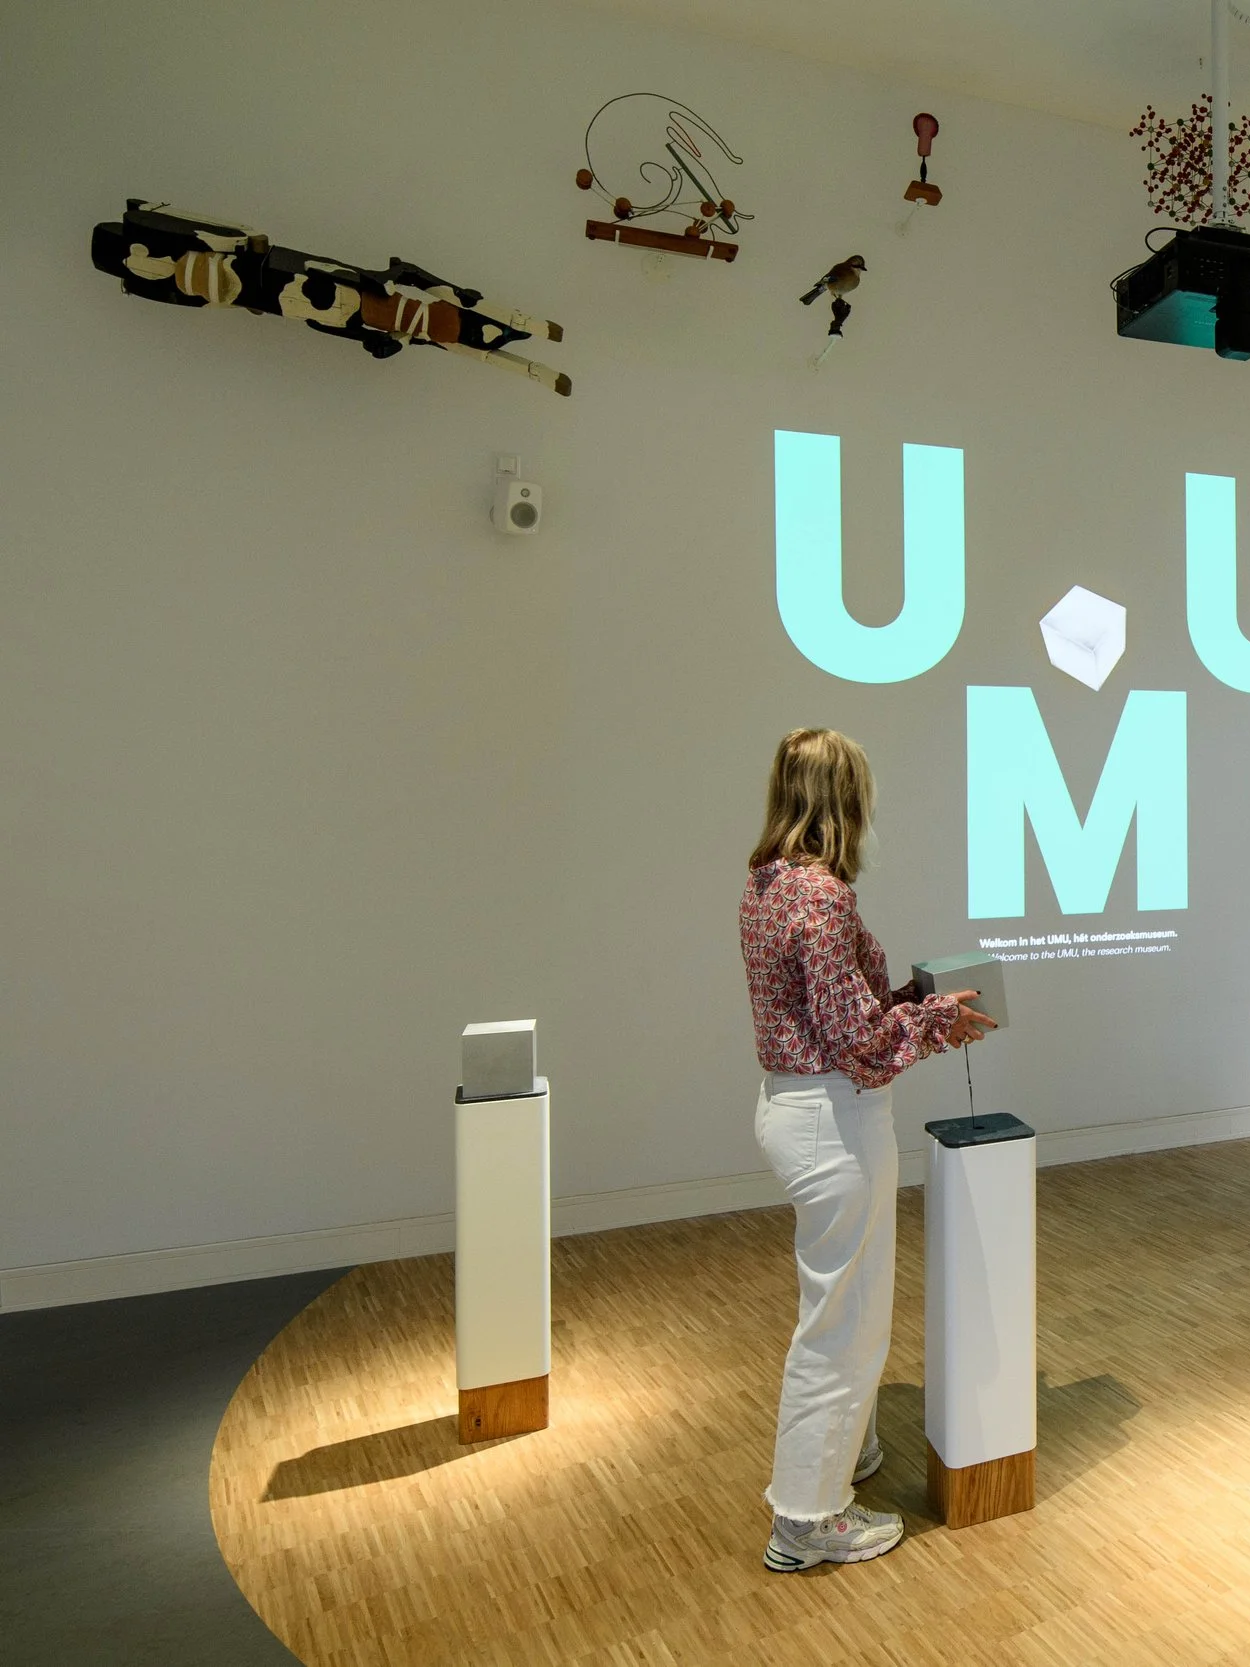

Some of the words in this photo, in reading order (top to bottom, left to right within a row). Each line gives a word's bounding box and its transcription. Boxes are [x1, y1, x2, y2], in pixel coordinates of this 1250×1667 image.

[773, 429, 966, 684] U
[966, 686, 1189, 920] M
[979, 937, 1017, 949] Welkom
[1019, 936, 1028, 946] in
[1030, 935, 1046, 946] het
[1047, 933, 1072, 945] UMU,
[1090, 930, 1178, 942] onderzoeksmuseum.
[1030, 951, 1040, 960] to
[1041, 950, 1056, 959] the
[1082, 947, 1096, 957] the
[1097, 945, 1133, 956] research
[1134, 944, 1172, 953] museum.
